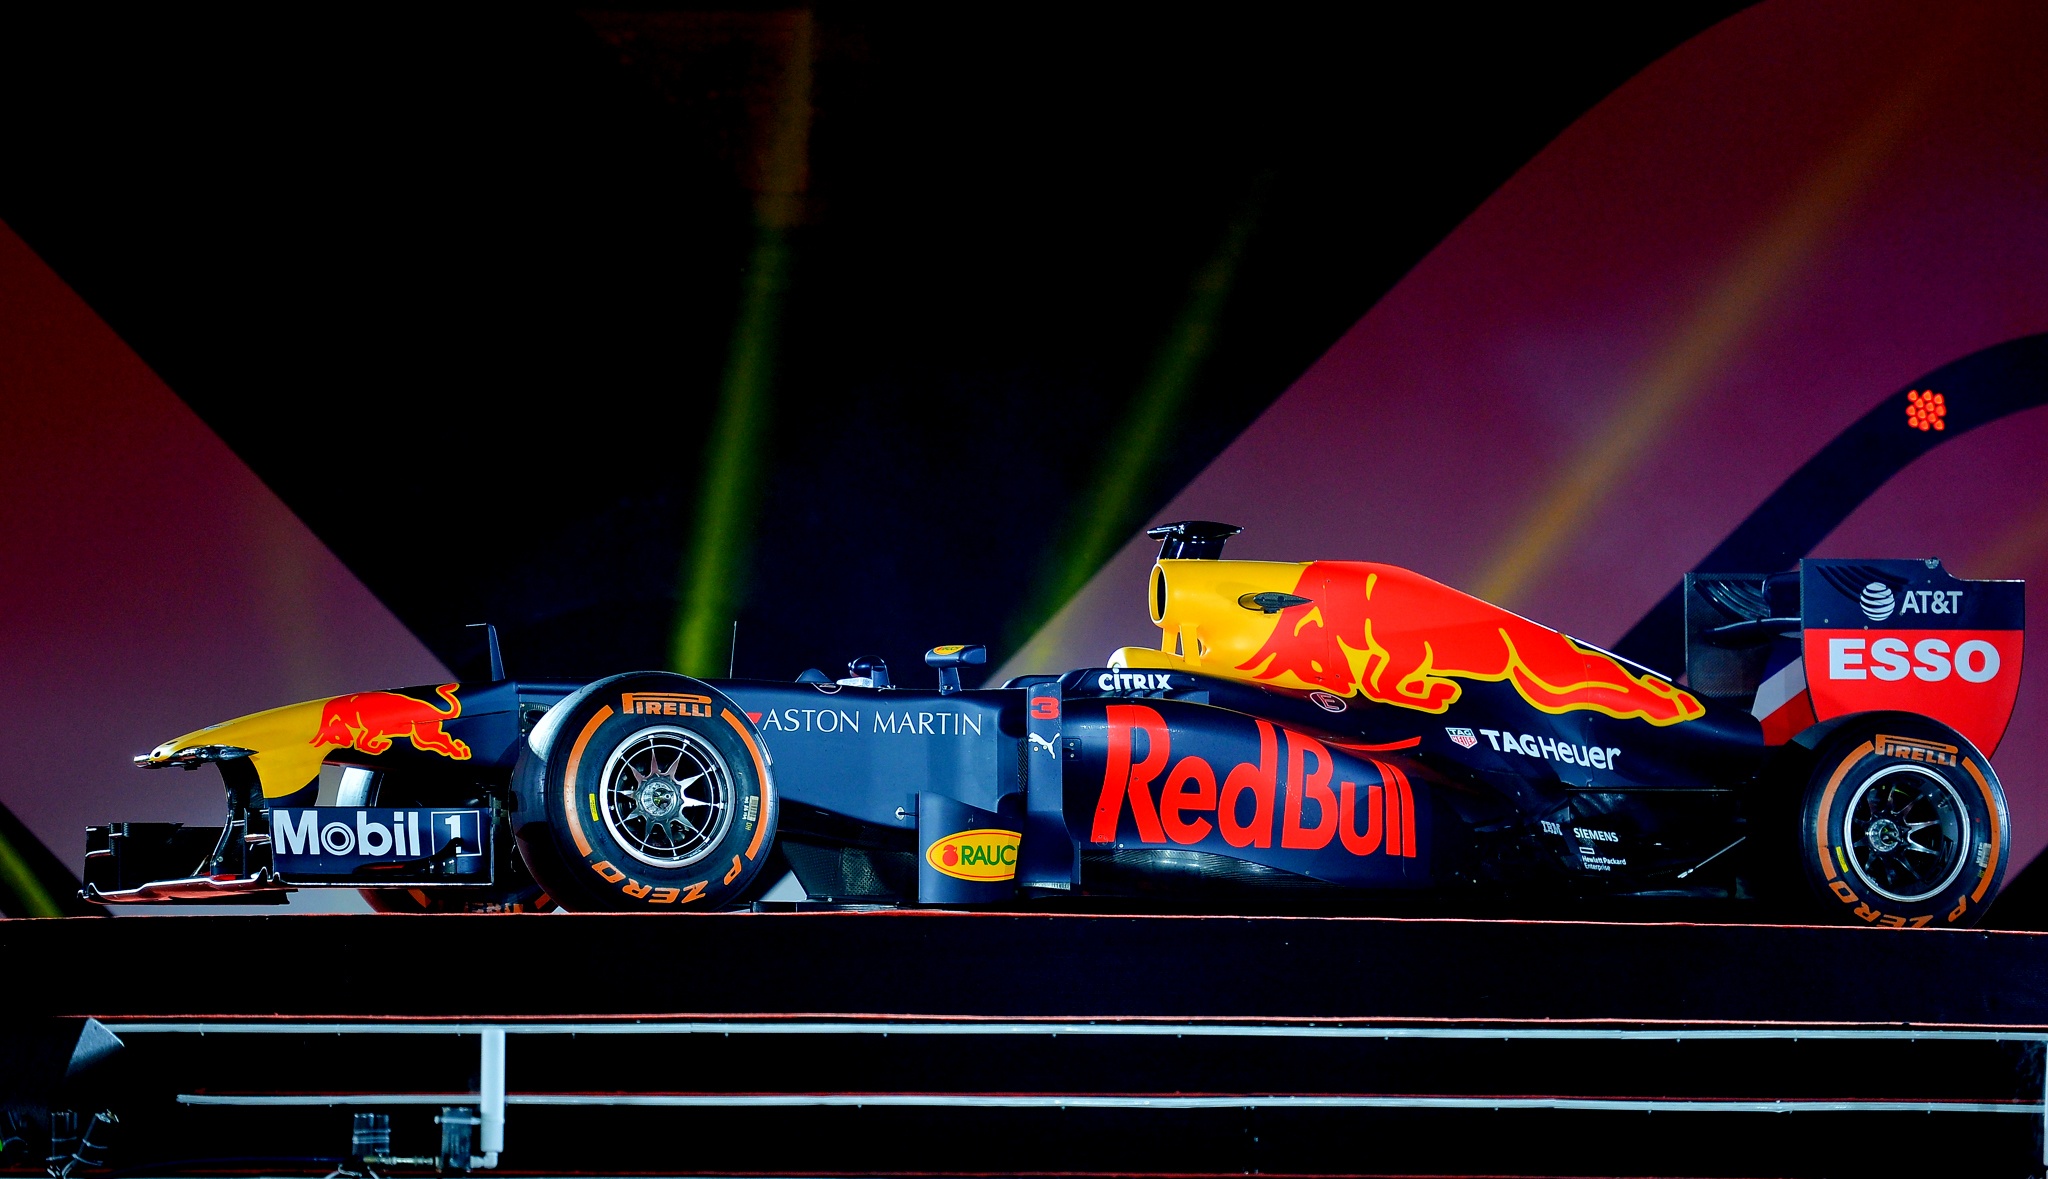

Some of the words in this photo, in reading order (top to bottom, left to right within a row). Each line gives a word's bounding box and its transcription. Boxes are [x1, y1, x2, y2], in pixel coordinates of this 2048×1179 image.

[1902, 590, 1963, 614] AT&T
[1829, 637, 2001, 683] ESSO
[621, 692, 712, 718] PIRELLI
[1030, 696, 1060, 720] 3
[762, 708, 860, 733] ASTON
[873, 710, 983, 736] MARTIN
[1875, 733, 1959, 768] PIRELLI
[272, 809, 421, 857] Mobil
[1541, 820, 1563, 836] IBM
[1573, 827, 1619, 843] SIEMENS
[961, 845, 1020, 866] RAUC
[1582, 855, 1604, 865] Hewlett
[1603, 857, 1627, 866] Packard
[1584, 862, 1611, 872] Enterprise
[590, 860, 709, 904] ZERO
[723, 854, 743, 886] P
